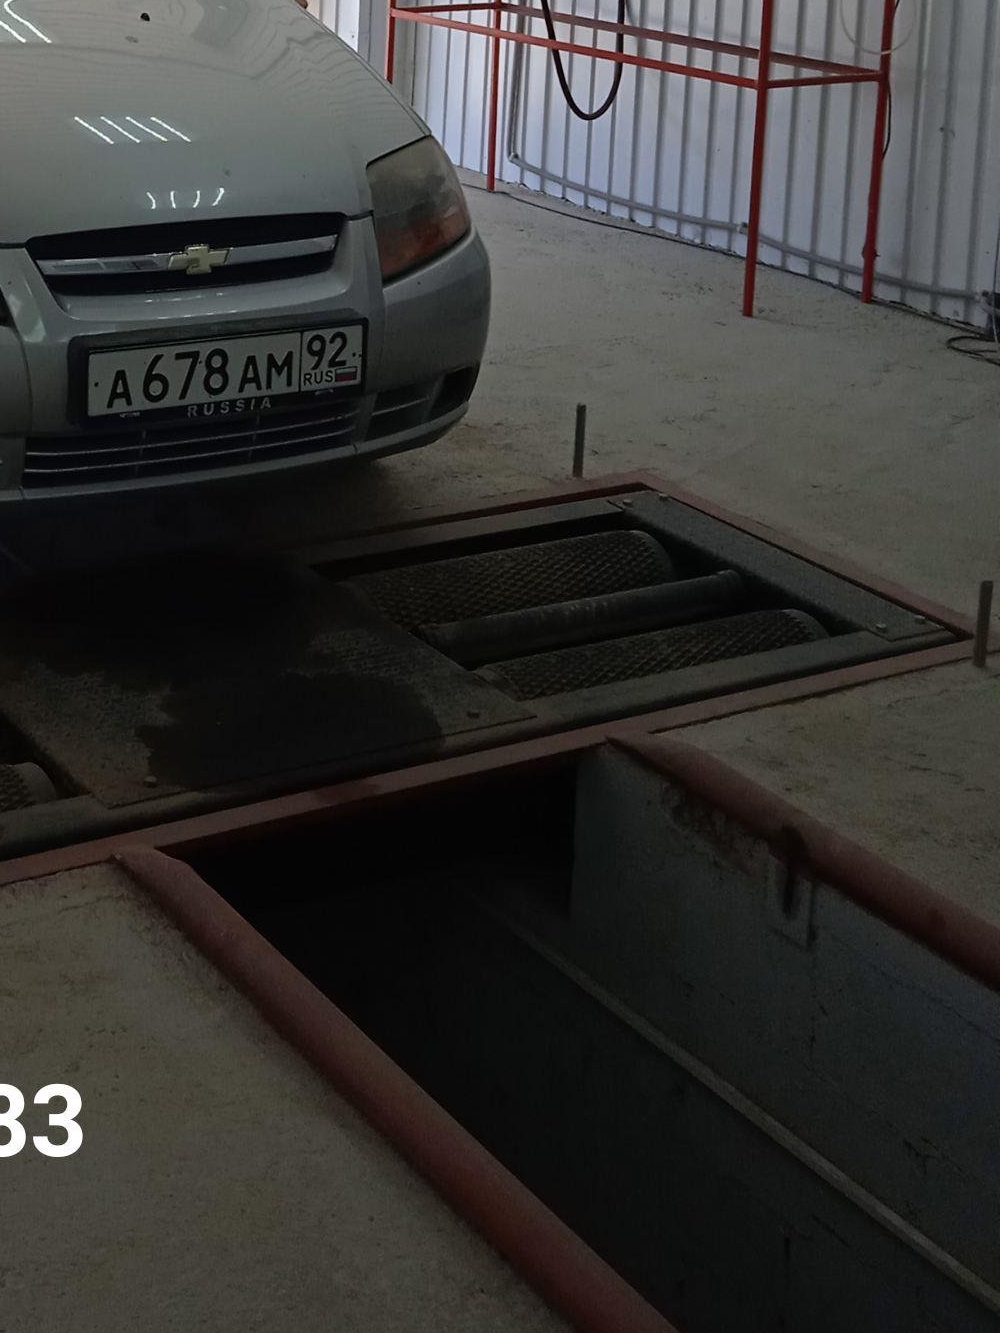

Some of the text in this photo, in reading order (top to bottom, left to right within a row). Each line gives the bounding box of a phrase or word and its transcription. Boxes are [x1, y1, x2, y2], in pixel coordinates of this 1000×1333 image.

[306, 331, 347, 370] 92
[302, 370, 334, 386] RUS
[187, 397, 272, 417] RUSSIA
